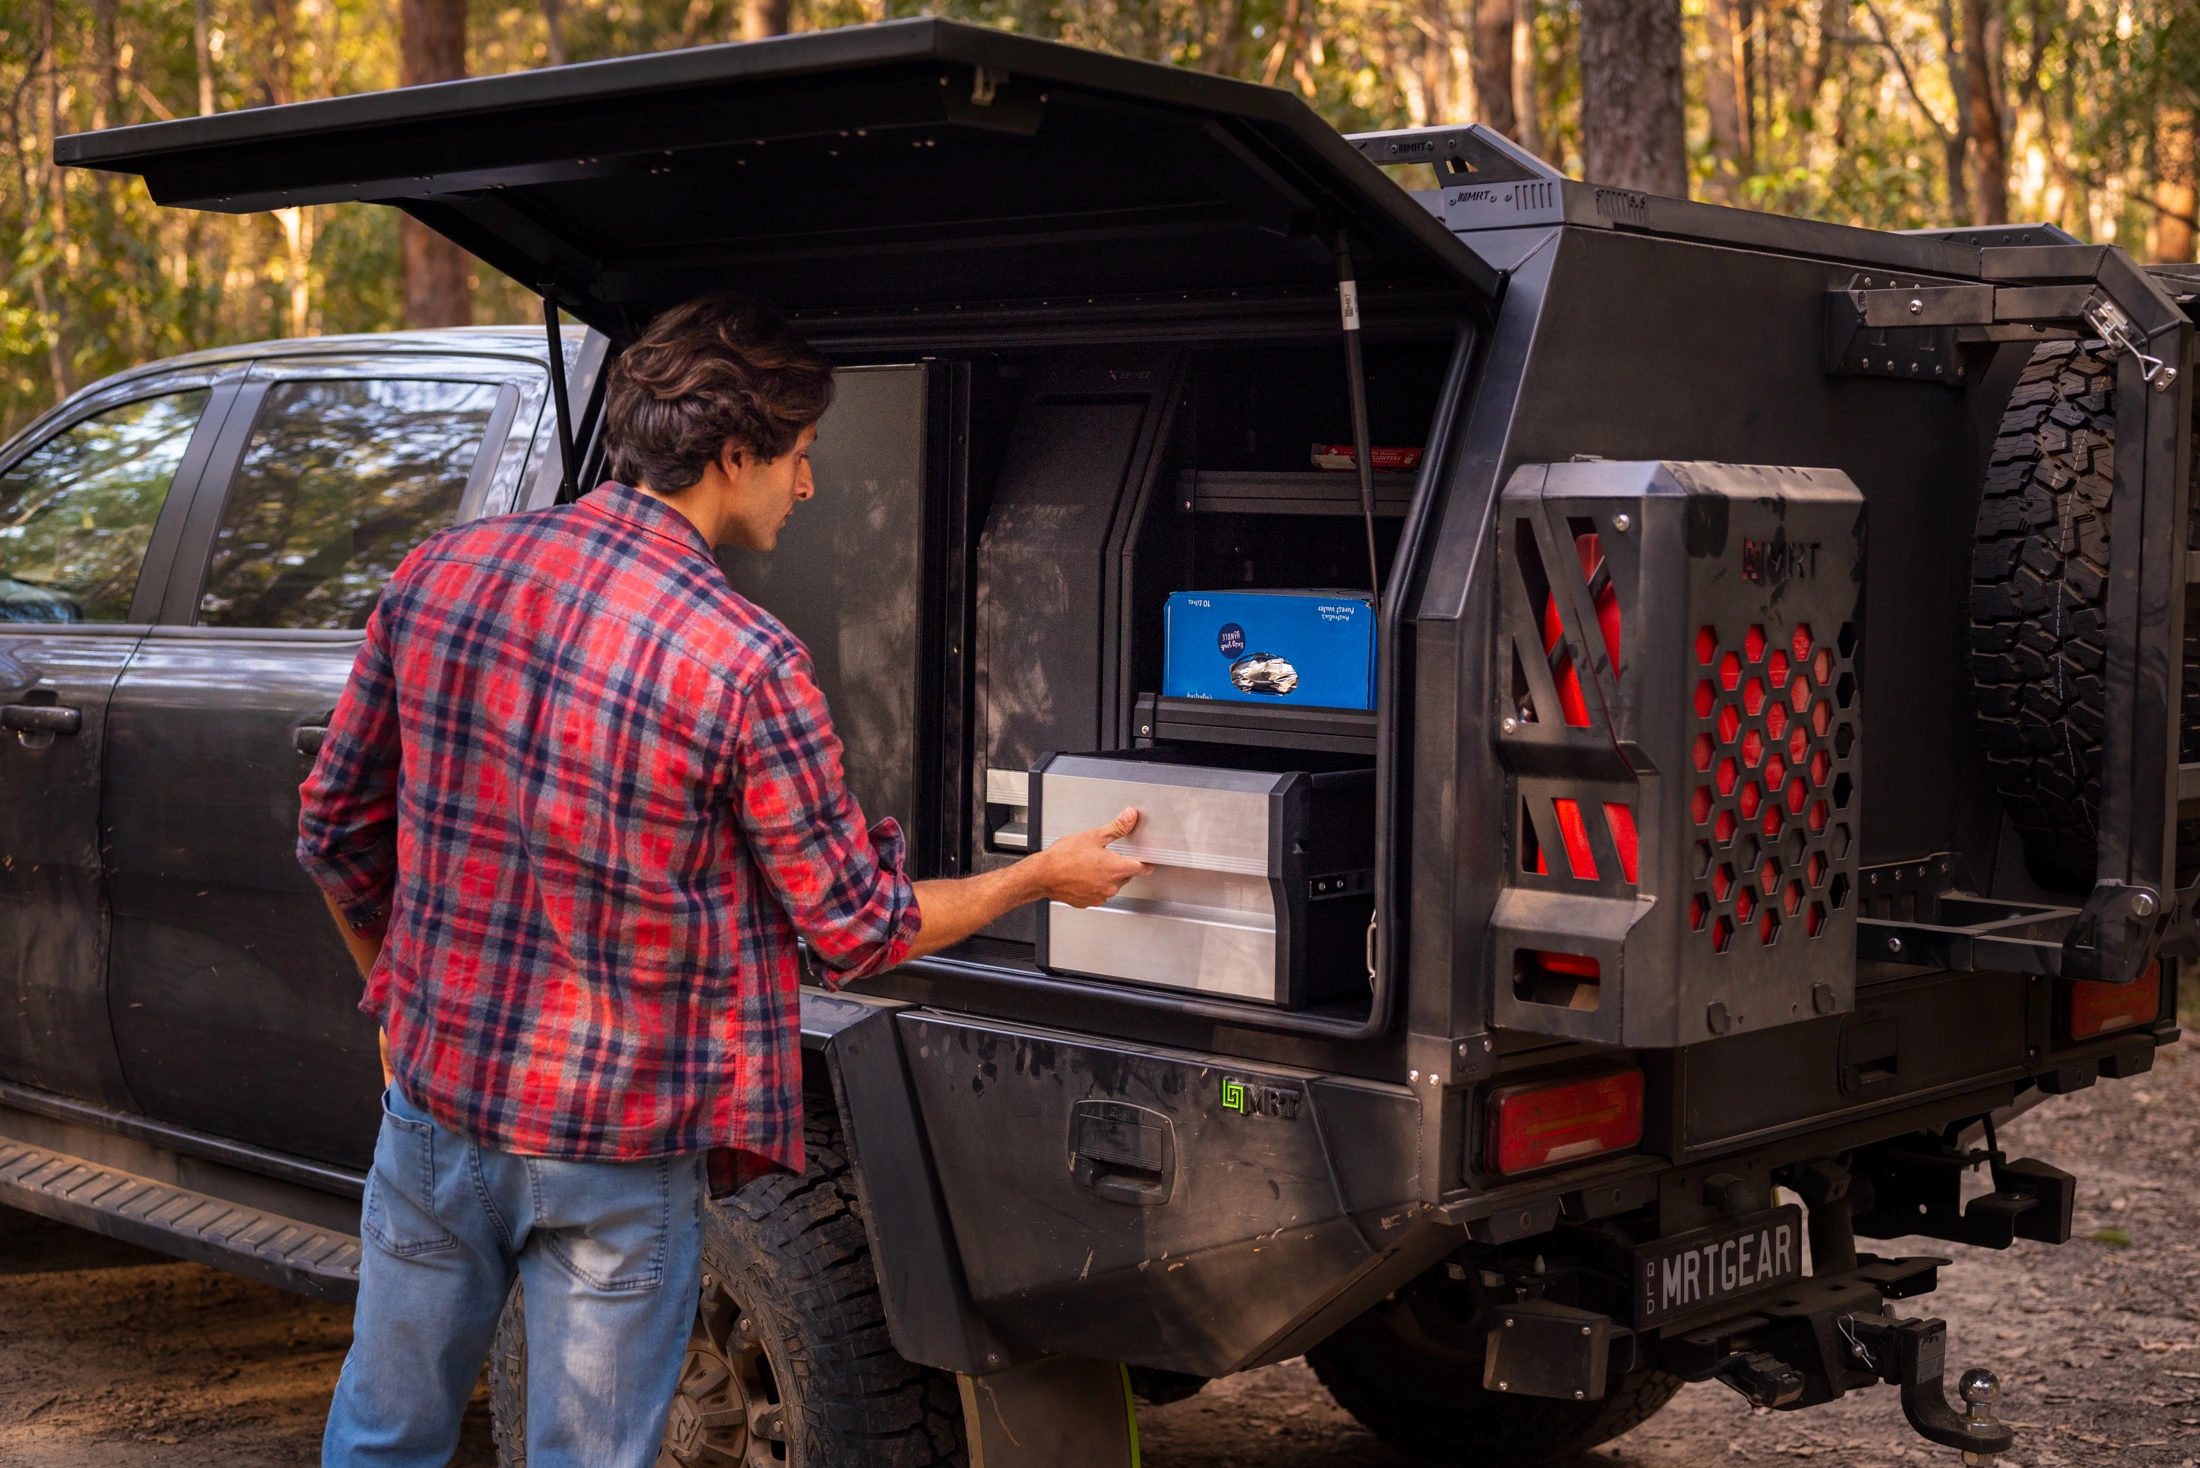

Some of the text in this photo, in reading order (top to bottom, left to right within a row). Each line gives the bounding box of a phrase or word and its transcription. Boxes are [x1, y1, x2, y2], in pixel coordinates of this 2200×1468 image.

[1407, 142, 1426, 152] MRT
[1467, 190, 1491, 202] MRT
[1344, 293, 1352, 308] MRT
[1767, 542, 1821, 580] MRT
[1188, 599, 1211, 608] 10 Litres
[1317, 605, 1355, 615] Purest Water
[1245, 1084, 1300, 1119] MRT
[1662, 1224, 1792, 1310] MRTGEAR
[1646, 1262, 1655, 1315] QLD
